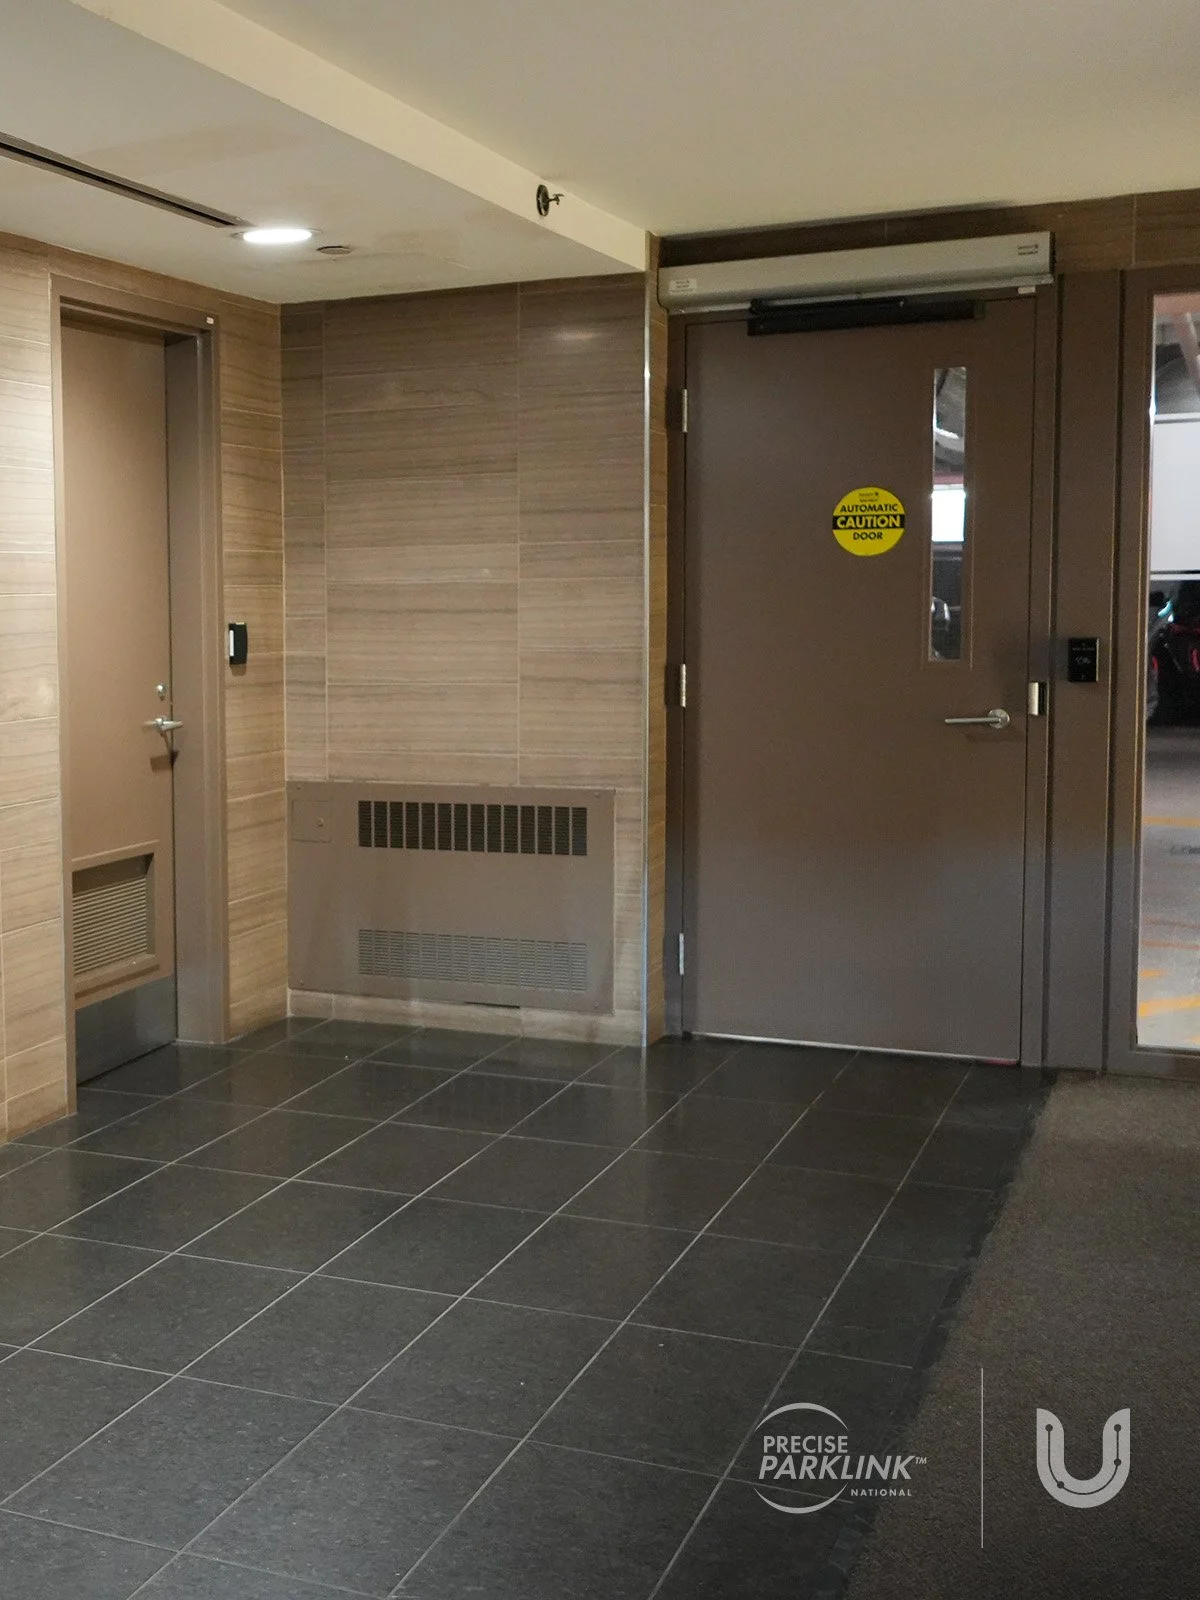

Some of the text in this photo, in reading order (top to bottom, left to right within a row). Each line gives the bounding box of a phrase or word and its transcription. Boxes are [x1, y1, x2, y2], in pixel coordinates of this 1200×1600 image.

[840, 504, 898, 512] AUTOMATIC
[837, 516, 900, 528] CAUTION
[853, 532, 882, 540] DOOR
